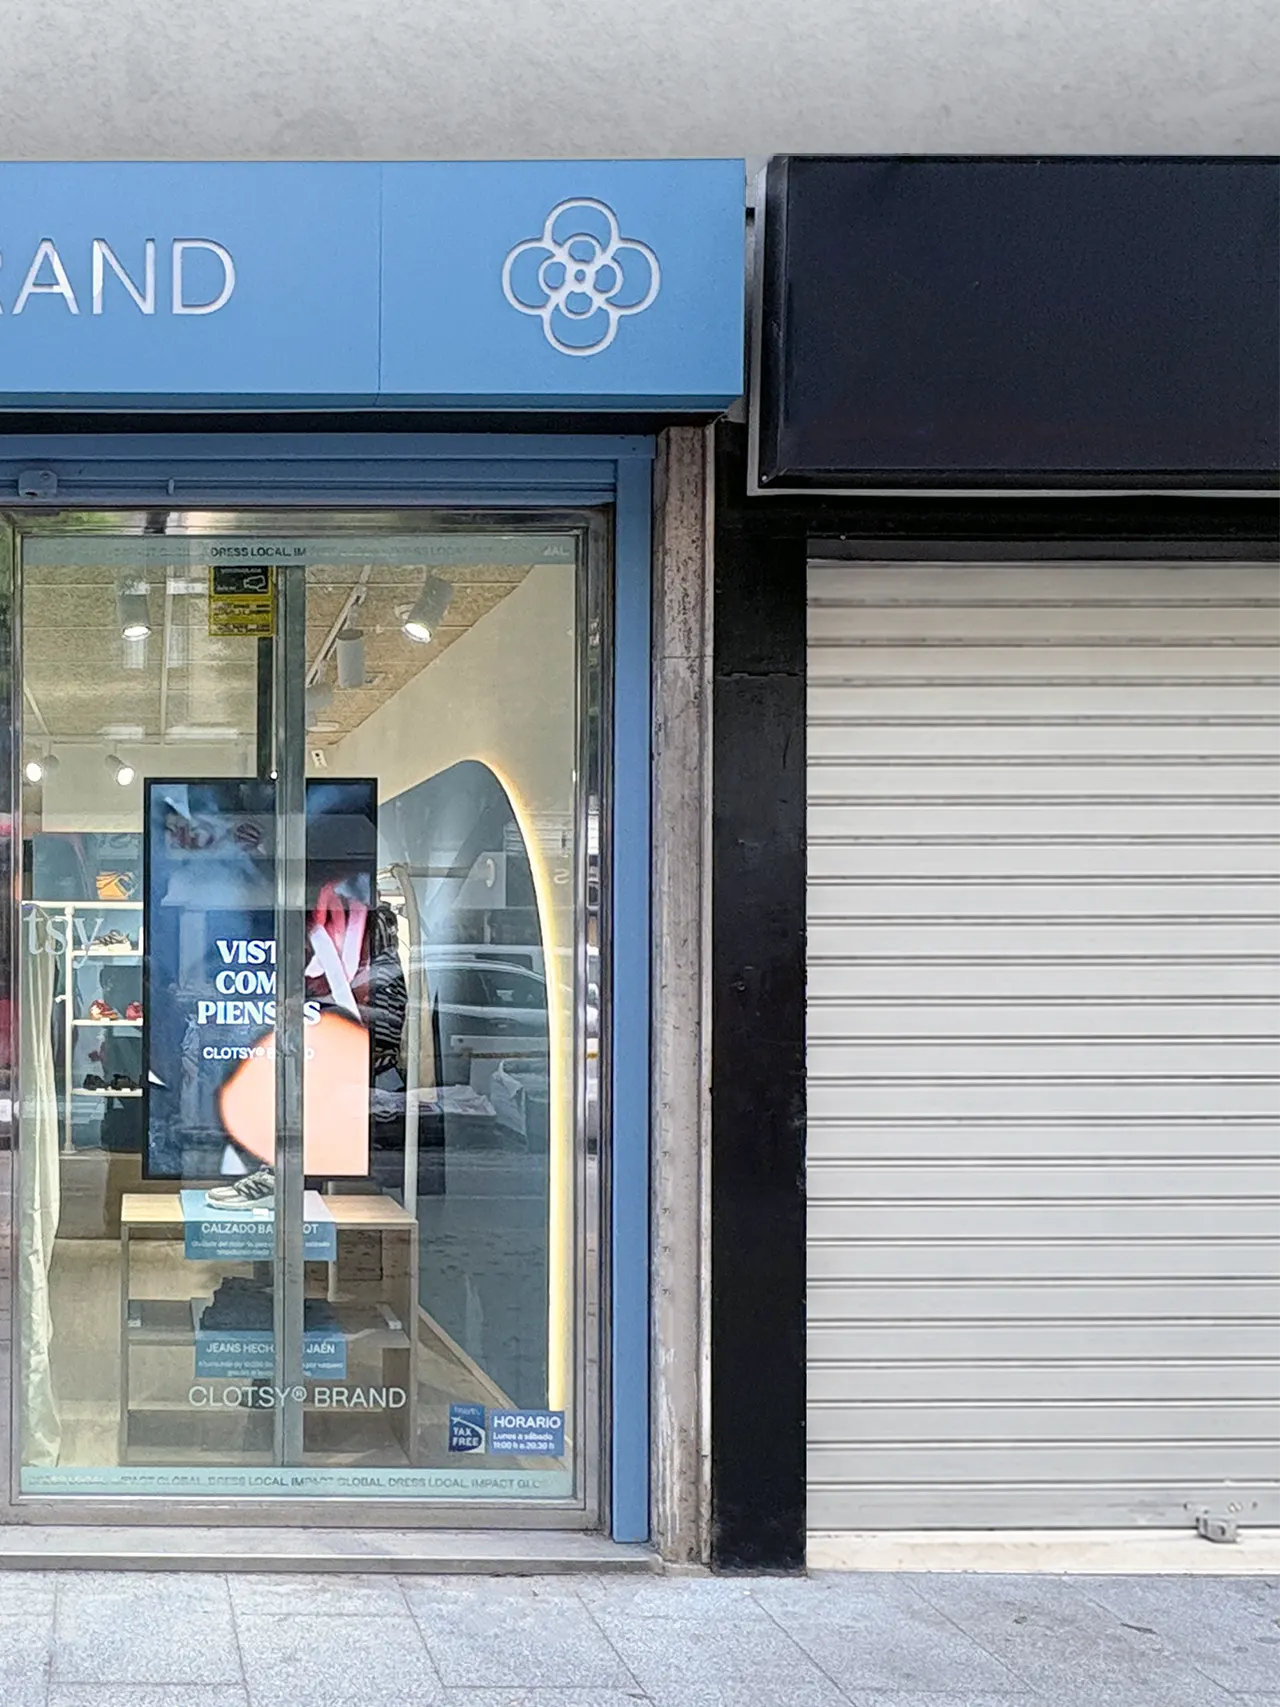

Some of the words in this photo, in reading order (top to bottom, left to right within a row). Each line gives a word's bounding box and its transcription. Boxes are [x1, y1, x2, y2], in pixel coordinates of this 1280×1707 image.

[216, 940, 276, 964] VIST
[216, 970, 276, 994] COM
[197, 1001, 321, 1025] PIENSS
[201, 1223, 256, 1235] CALZADO
[206, 1343, 242, 1353] JEANS
[188, 1385, 308, 1408] CLOTSY®
[314, 1387, 407, 1408] BRAND
[493, 1415, 561, 1429] HORARIO
[453, 1427, 473, 1436] TAX
[452, 1437, 480, 1447] FREE
